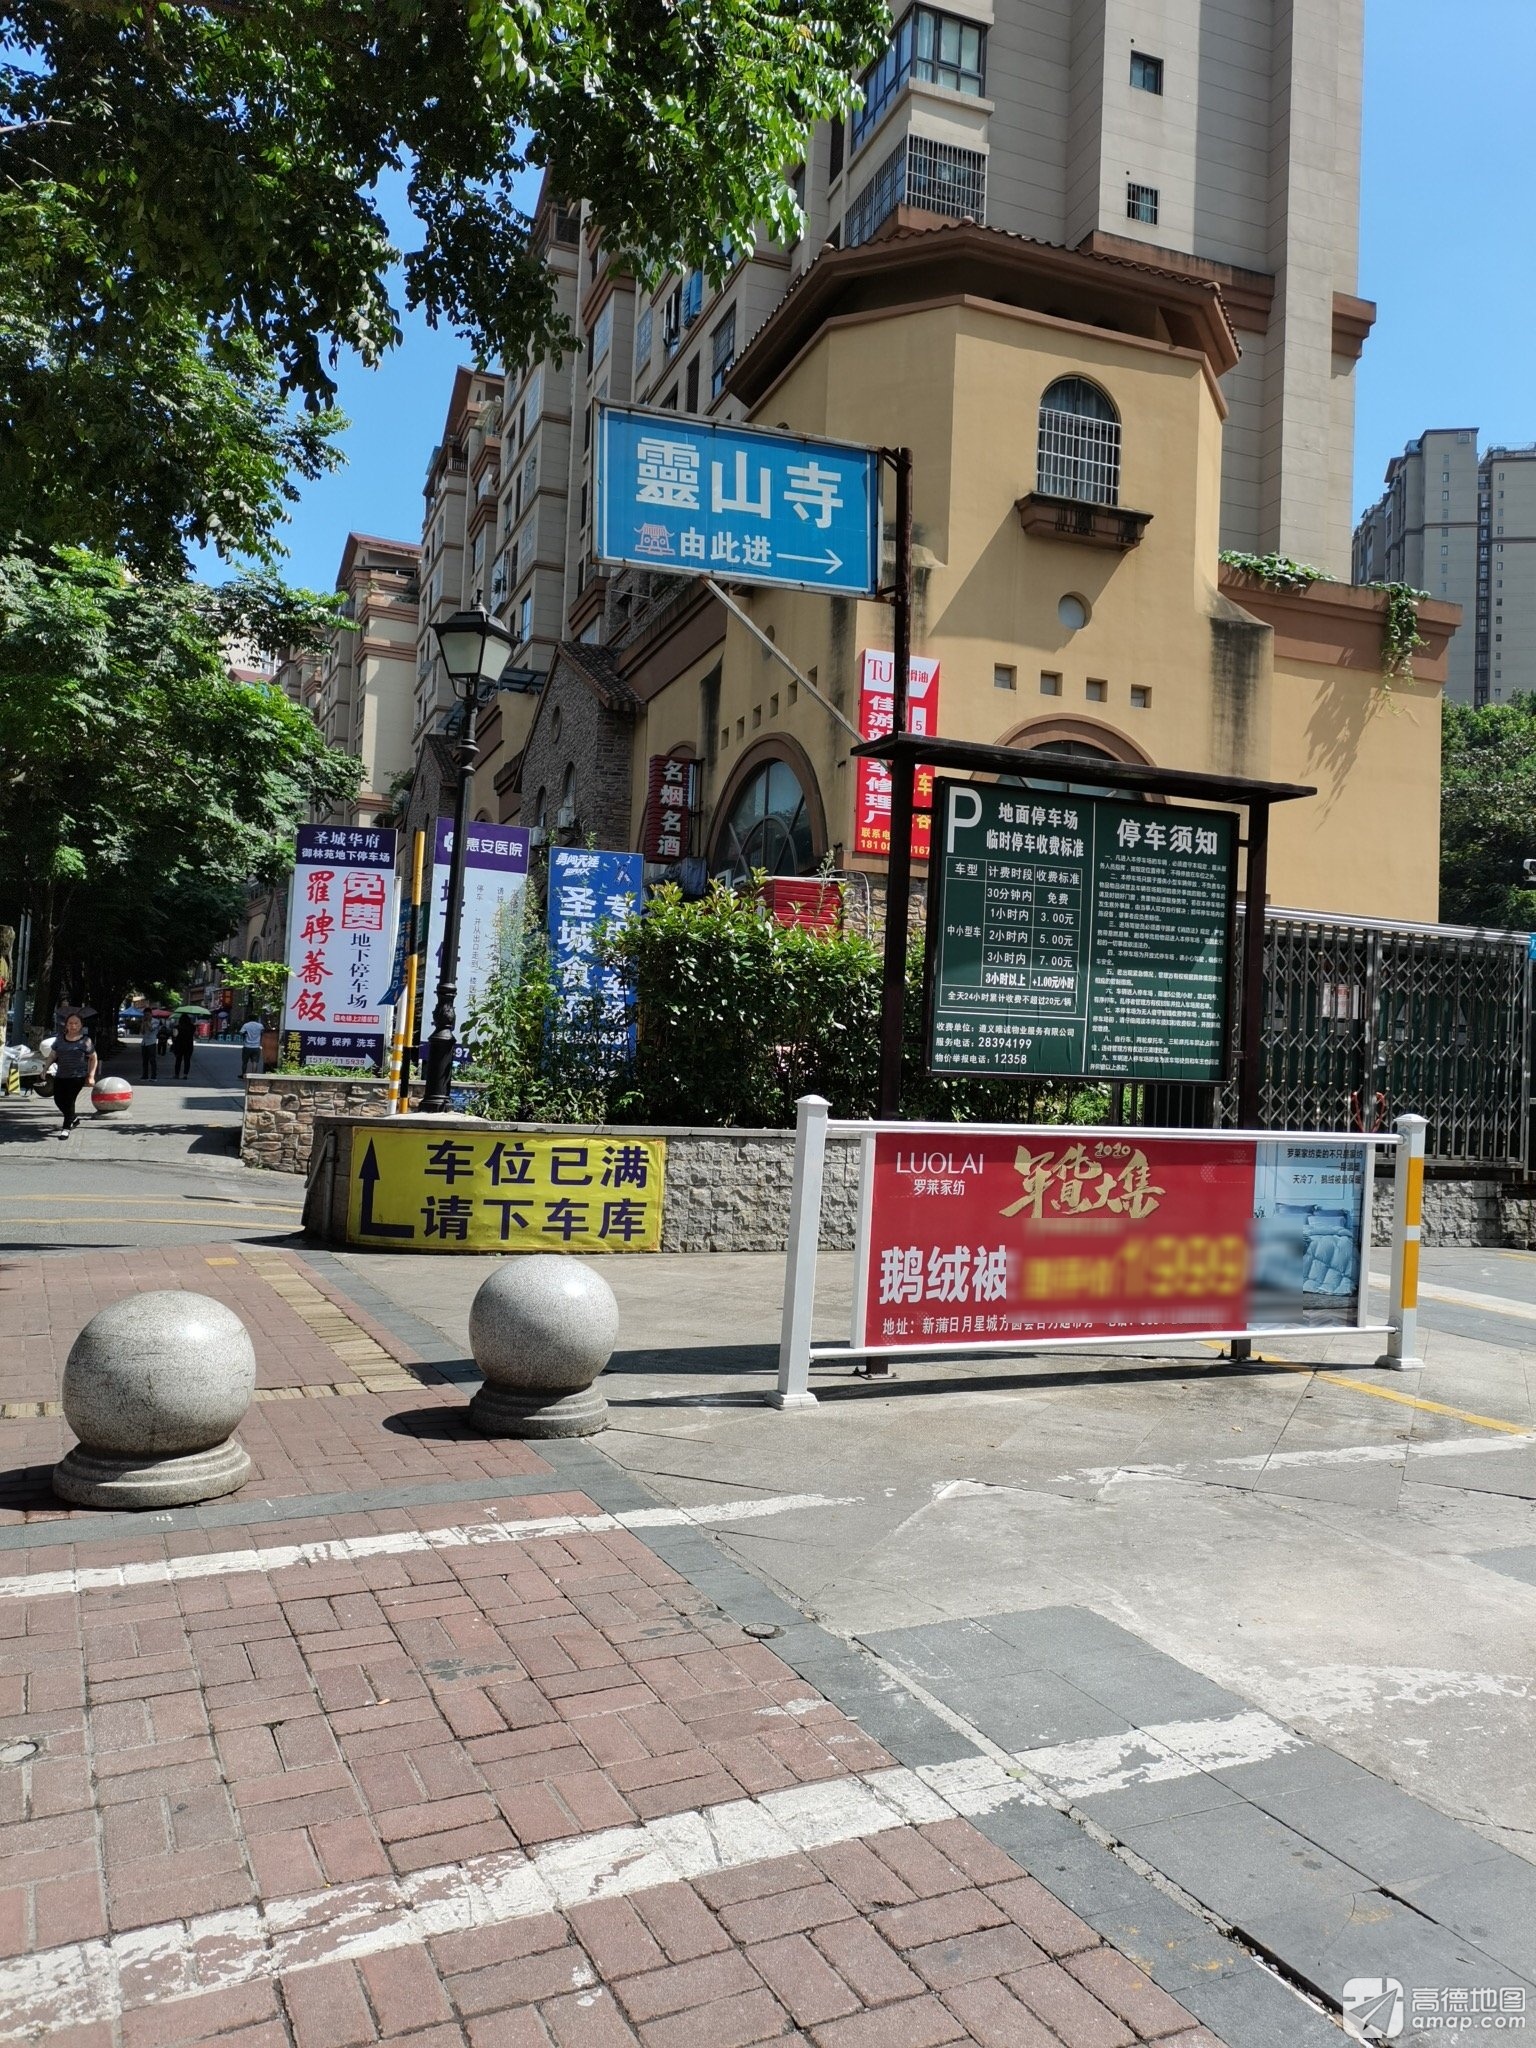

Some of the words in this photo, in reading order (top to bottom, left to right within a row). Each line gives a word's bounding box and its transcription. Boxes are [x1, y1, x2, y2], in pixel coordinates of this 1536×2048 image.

[636, 437, 843, 529] 靈山寺
[680, 527, 771, 567] 由此进
[657, 760, 684, 857] 名烟名酒
[947, 786, 983, 853] P
[998, 802, 1079, 831] 地面停车场
[313, 831, 381, 848] 圣城华府
[465, 837, 523, 857] 惠安医院
[986, 828, 1084, 858] 临时停车收费标准
[1116, 818, 1218, 855] 停车须知
[301, 847, 391, 863] 御林苑地下停车场
[954, 863, 979, 876] 车型
[987, 865, 1033, 881] 计费时段
[1036, 869, 1080, 885] 收费标准
[342, 871, 386, 930] 免费
[987, 887, 1032, 902] 30分钟内
[1047, 891, 1069, 905] 免费
[990, 907, 1029, 921] 1小时内
[947, 925, 982, 938] 中小型车
[989, 930, 1028, 944] 2小时内
[347, 933, 372, 1009] 地下停车场
[987, 952, 1026, 965] 3小时内
[985, 972, 1026, 987] 3小时以上
[306, 1035, 327, 1047] 汽修
[331, 1037, 352, 1048] 保养
[356, 1038, 377, 1048] 洗车
[423, 1138, 650, 1189] 车位已满
[896, 1151, 984, 1175] LUOLAI
[913, 1179, 965, 1196] 罗莱家纺
[998, 1142, 1167, 1218] 年货大集
[420, 1195, 648, 1242] 请下车库
[879, 1244, 1009, 1305] 鹅绒被
